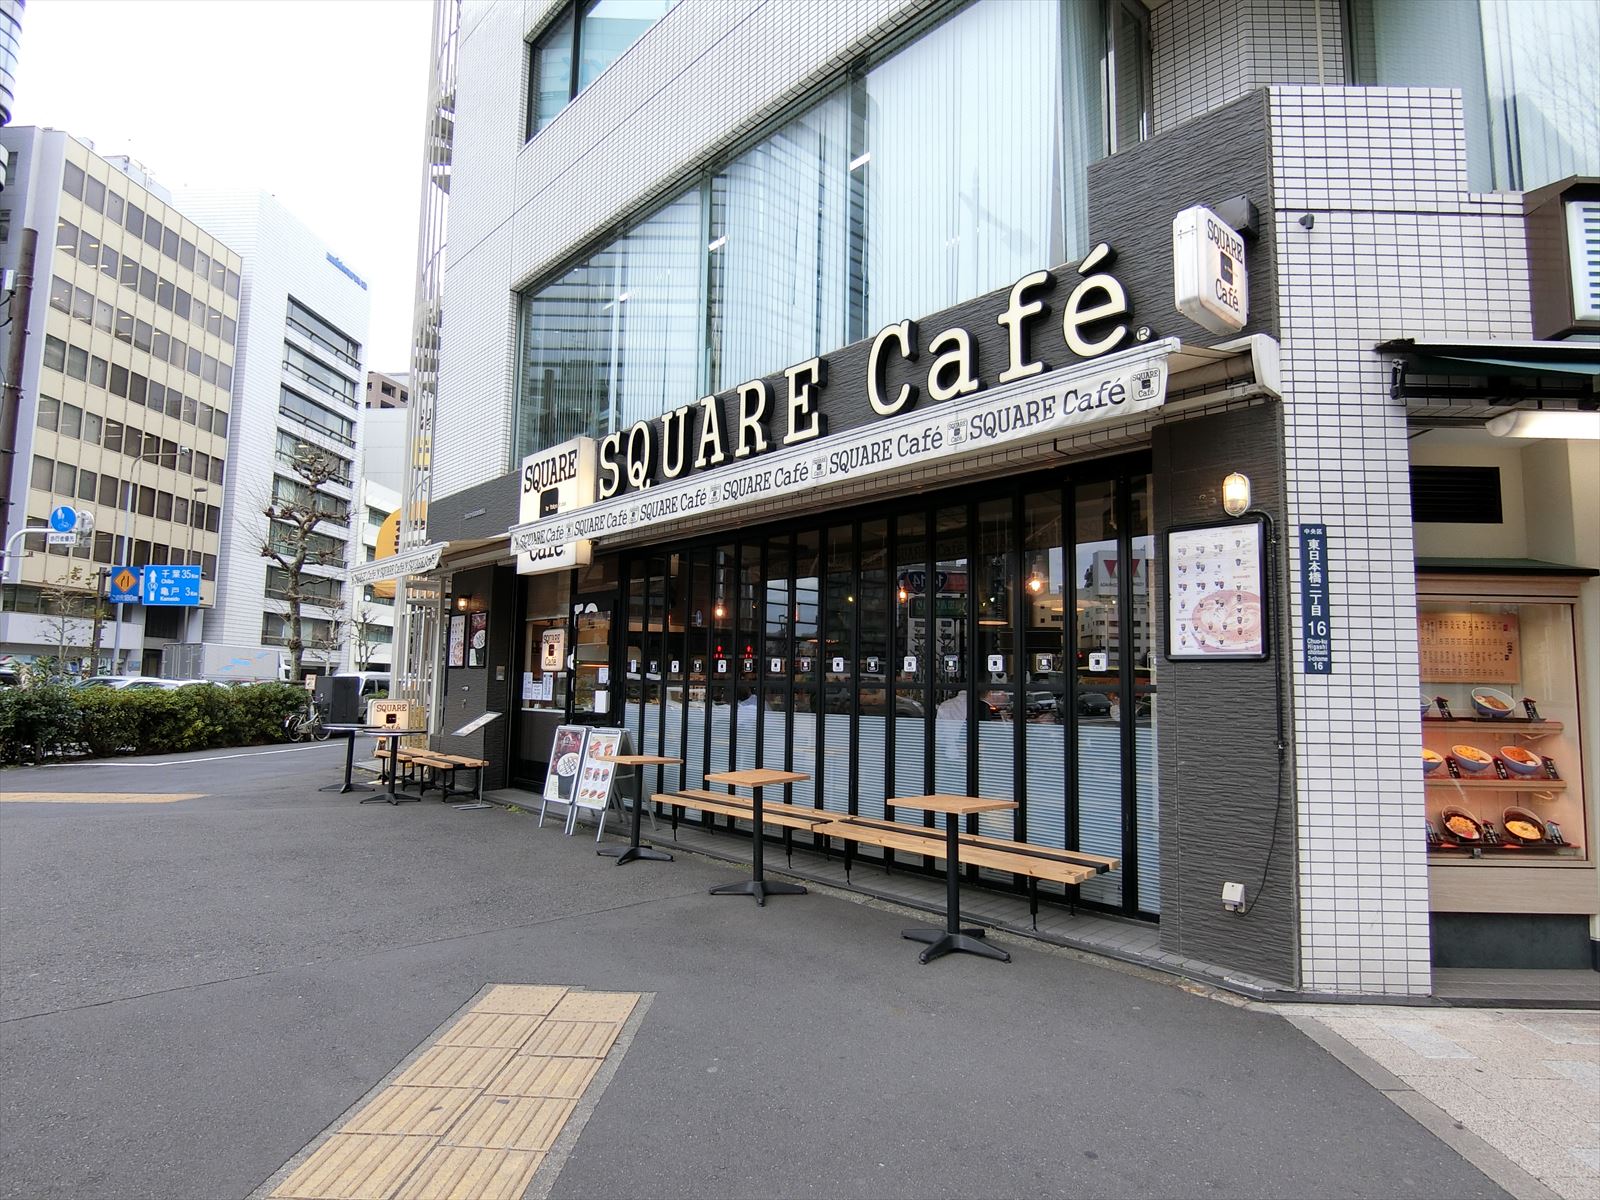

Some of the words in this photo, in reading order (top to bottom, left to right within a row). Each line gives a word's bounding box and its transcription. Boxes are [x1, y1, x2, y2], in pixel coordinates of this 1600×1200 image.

[1207, 218, 1243, 264] SQUARE
[1215, 278, 1239, 312] Café
[599, 356, 822, 500] SQUARE
[867, 240, 1130, 416] Café
[1132, 369, 1158, 382] SQUARE
[520, 530, 545, 549] SQUARE
[573, 515, 605, 537] SQUARE
[606, 511, 627, 529] Café
[640, 496, 678, 522] SQUARE
[680, 488, 706, 511] Café
[722, 472, 771, 501] SQUARE
[774, 461, 809, 487] Café
[829, 439, 892, 474] SQUARE
[898, 425, 943, 457] Café
[969, 396, 1056, 440] SQUARE
[1063, 378, 1126, 416] Café
[523, 449, 578, 493] SQUARE
[161, 569, 180, 579] 千葉
[1307, 538, 1322, 617] 東日本橋二丁目
[160, 587, 180, 596] 亀戸
[1308, 620, 1327, 636] 16
[1313, 662, 1323, 670] 16
[376, 704, 407, 713] SQUARE
